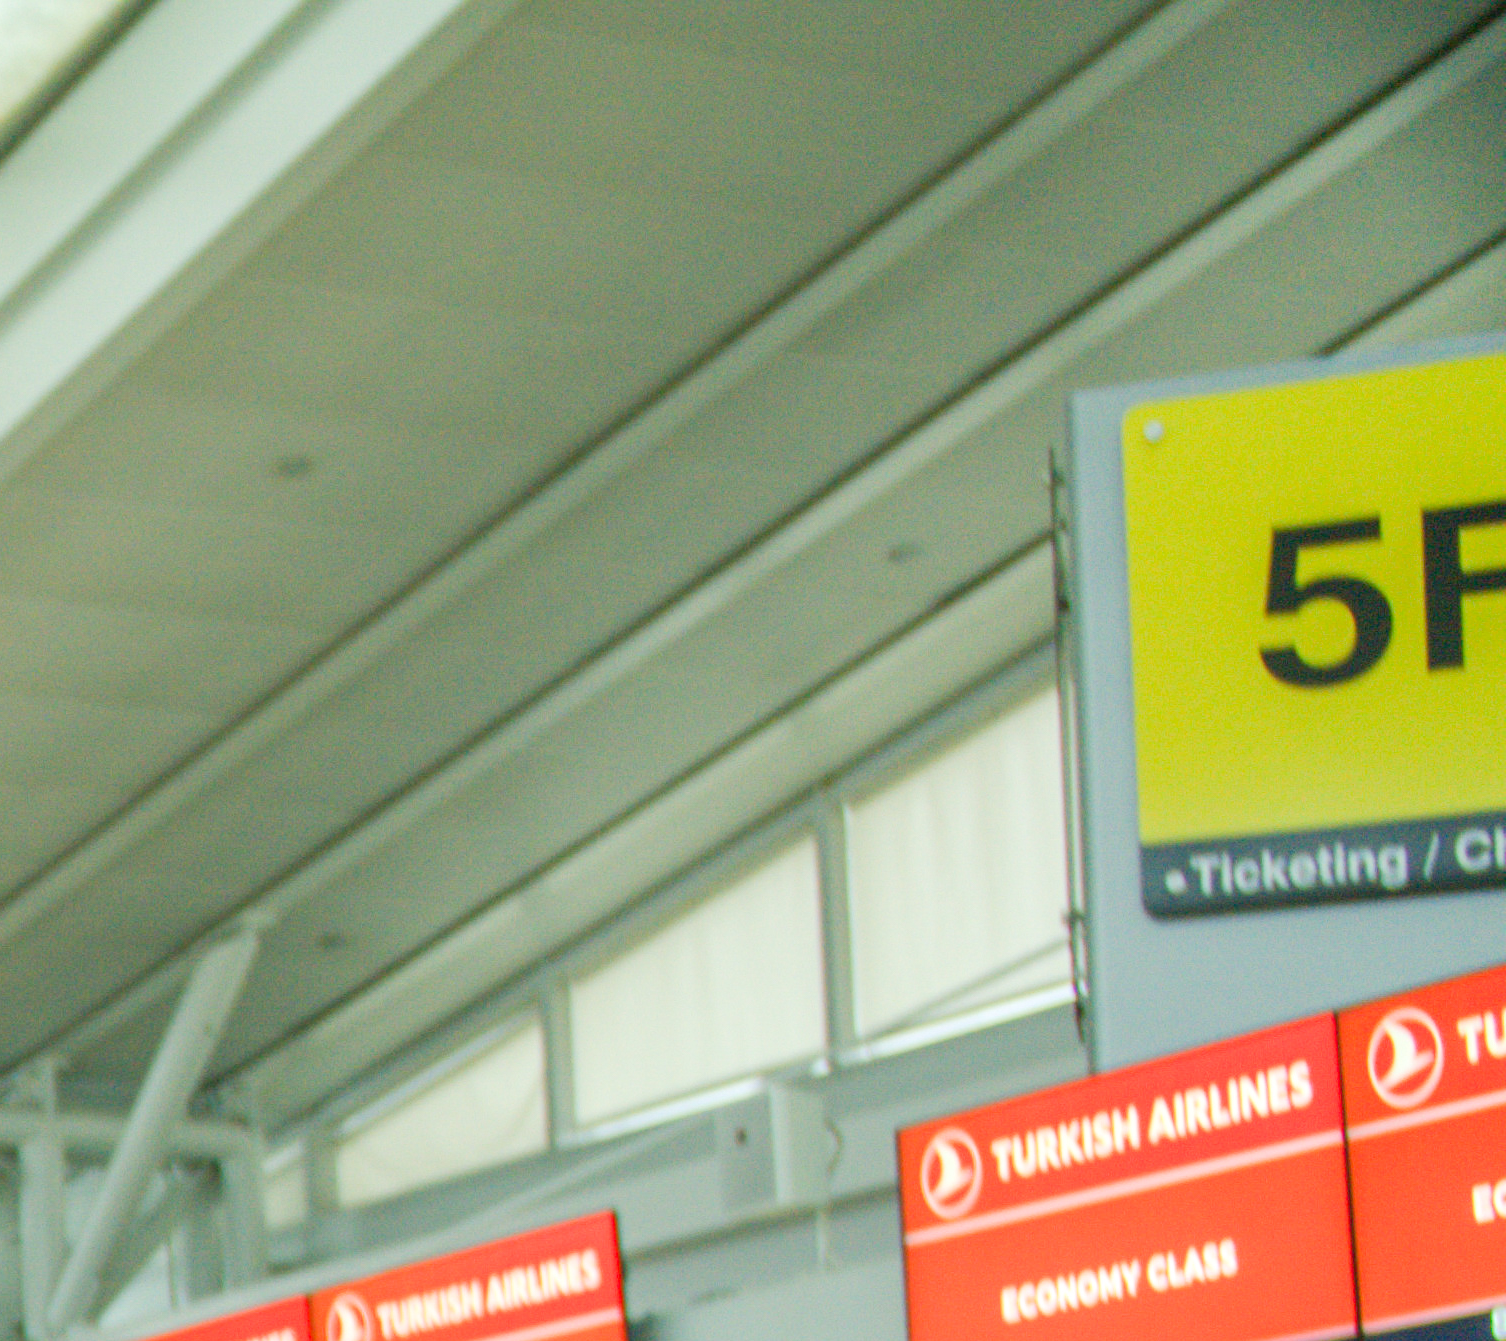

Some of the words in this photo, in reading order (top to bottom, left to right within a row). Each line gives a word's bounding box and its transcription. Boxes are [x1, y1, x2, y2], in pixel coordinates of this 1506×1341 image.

[1259, 498, 1506, 690] 5F
[1188, 842, 1409, 897] Ticketing
[990, 1103, 1141, 1184] TURKISH
[1148, 1059, 1313, 1145] AIRLINES
[377, 1278, 483, 1341] TURKISH
[486, 1248, 602, 1315] AIRLINES
[999, 1258, 1141, 1324] ECONOMY
[1146, 1237, 1239, 1292] CLASS
